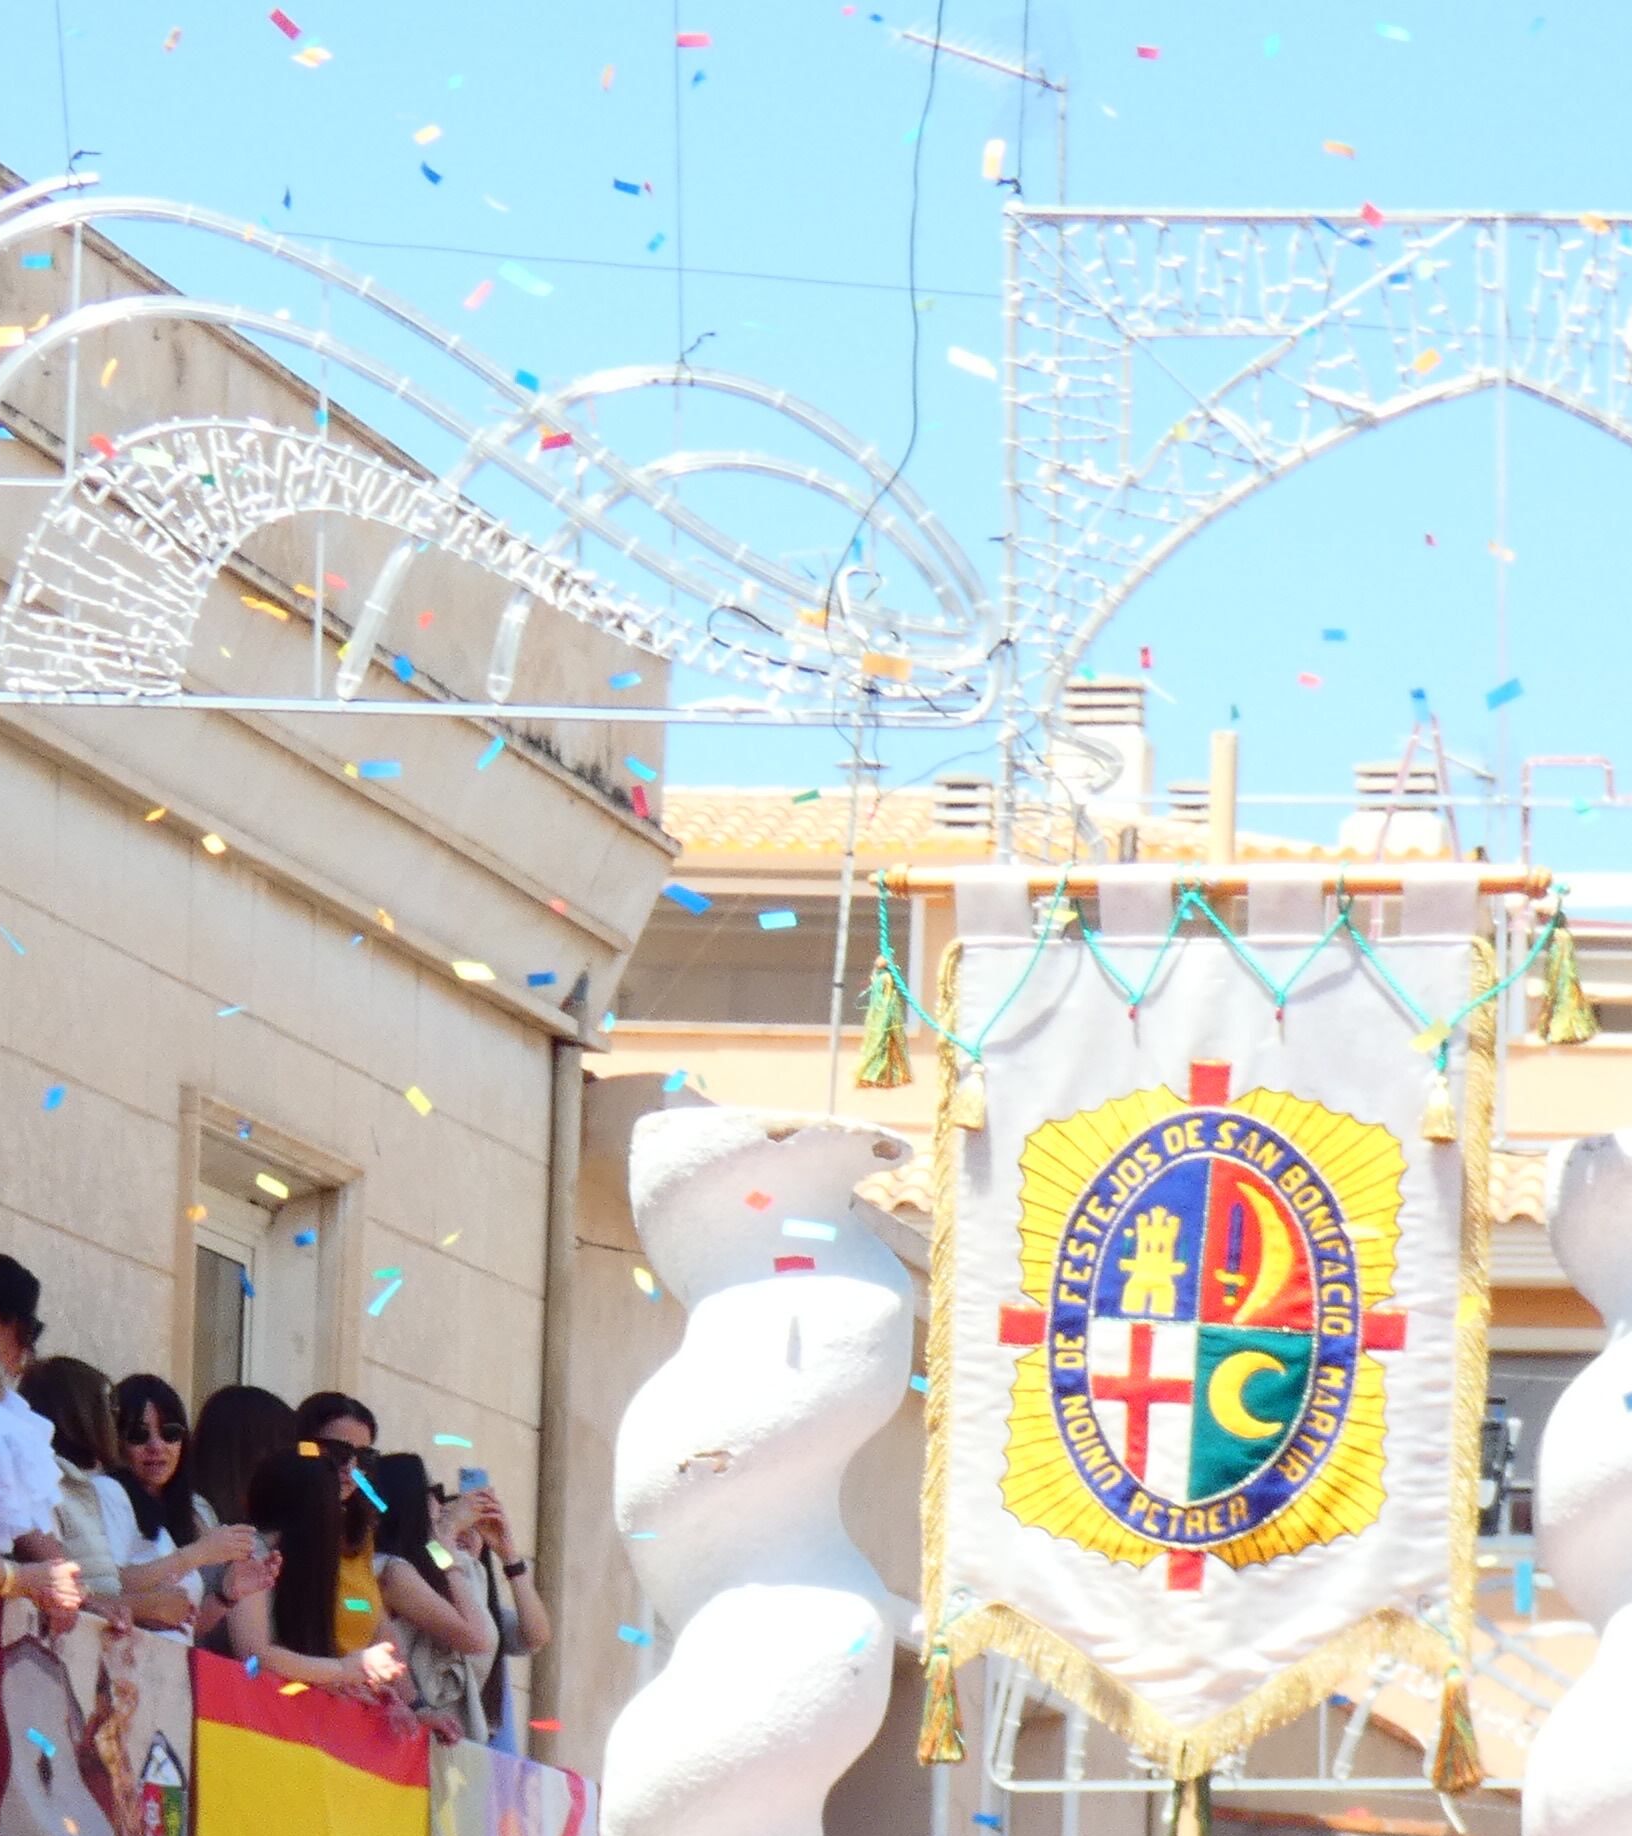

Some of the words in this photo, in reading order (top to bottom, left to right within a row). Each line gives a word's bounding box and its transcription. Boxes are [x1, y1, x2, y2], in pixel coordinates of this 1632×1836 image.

[1163, 1118, 1205, 1152] DE
[1214, 1119, 1284, 1176] SAN
[1060, 1138, 1164, 1307] FESTEJOS
[1277, 1162, 1353, 1338] BONIFACIO
[1054, 1331, 1085, 1371] DE
[1061, 1395, 1121, 1491] UNION
[1276, 1364, 1348, 1484] MARTIR
[1125, 1491, 1251, 1537] PETRER
